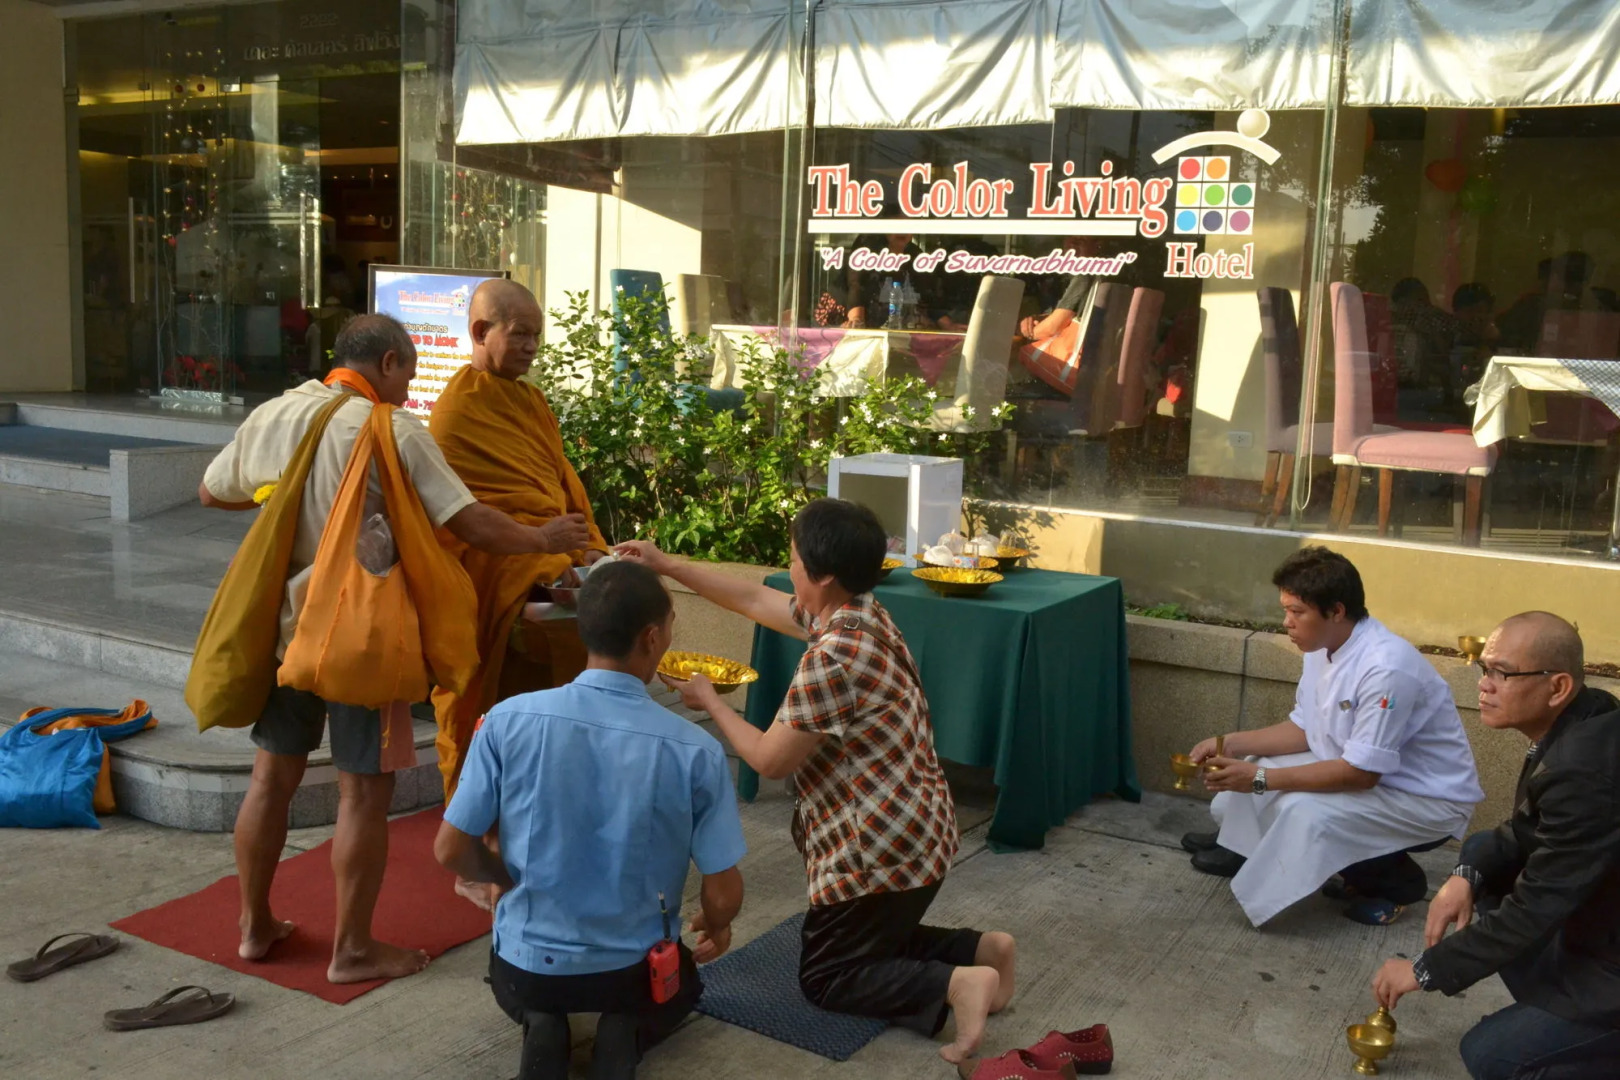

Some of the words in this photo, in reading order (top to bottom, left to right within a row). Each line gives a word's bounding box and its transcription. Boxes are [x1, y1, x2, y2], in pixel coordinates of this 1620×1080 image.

[807, 163, 884, 217] The
[898, 160, 1014, 218] Color
[1027, 160, 1173, 238] Living
[849, 247, 910, 271] Color
[913, 248, 947, 273] of
[1164, 242, 1254, 279] Hotel
